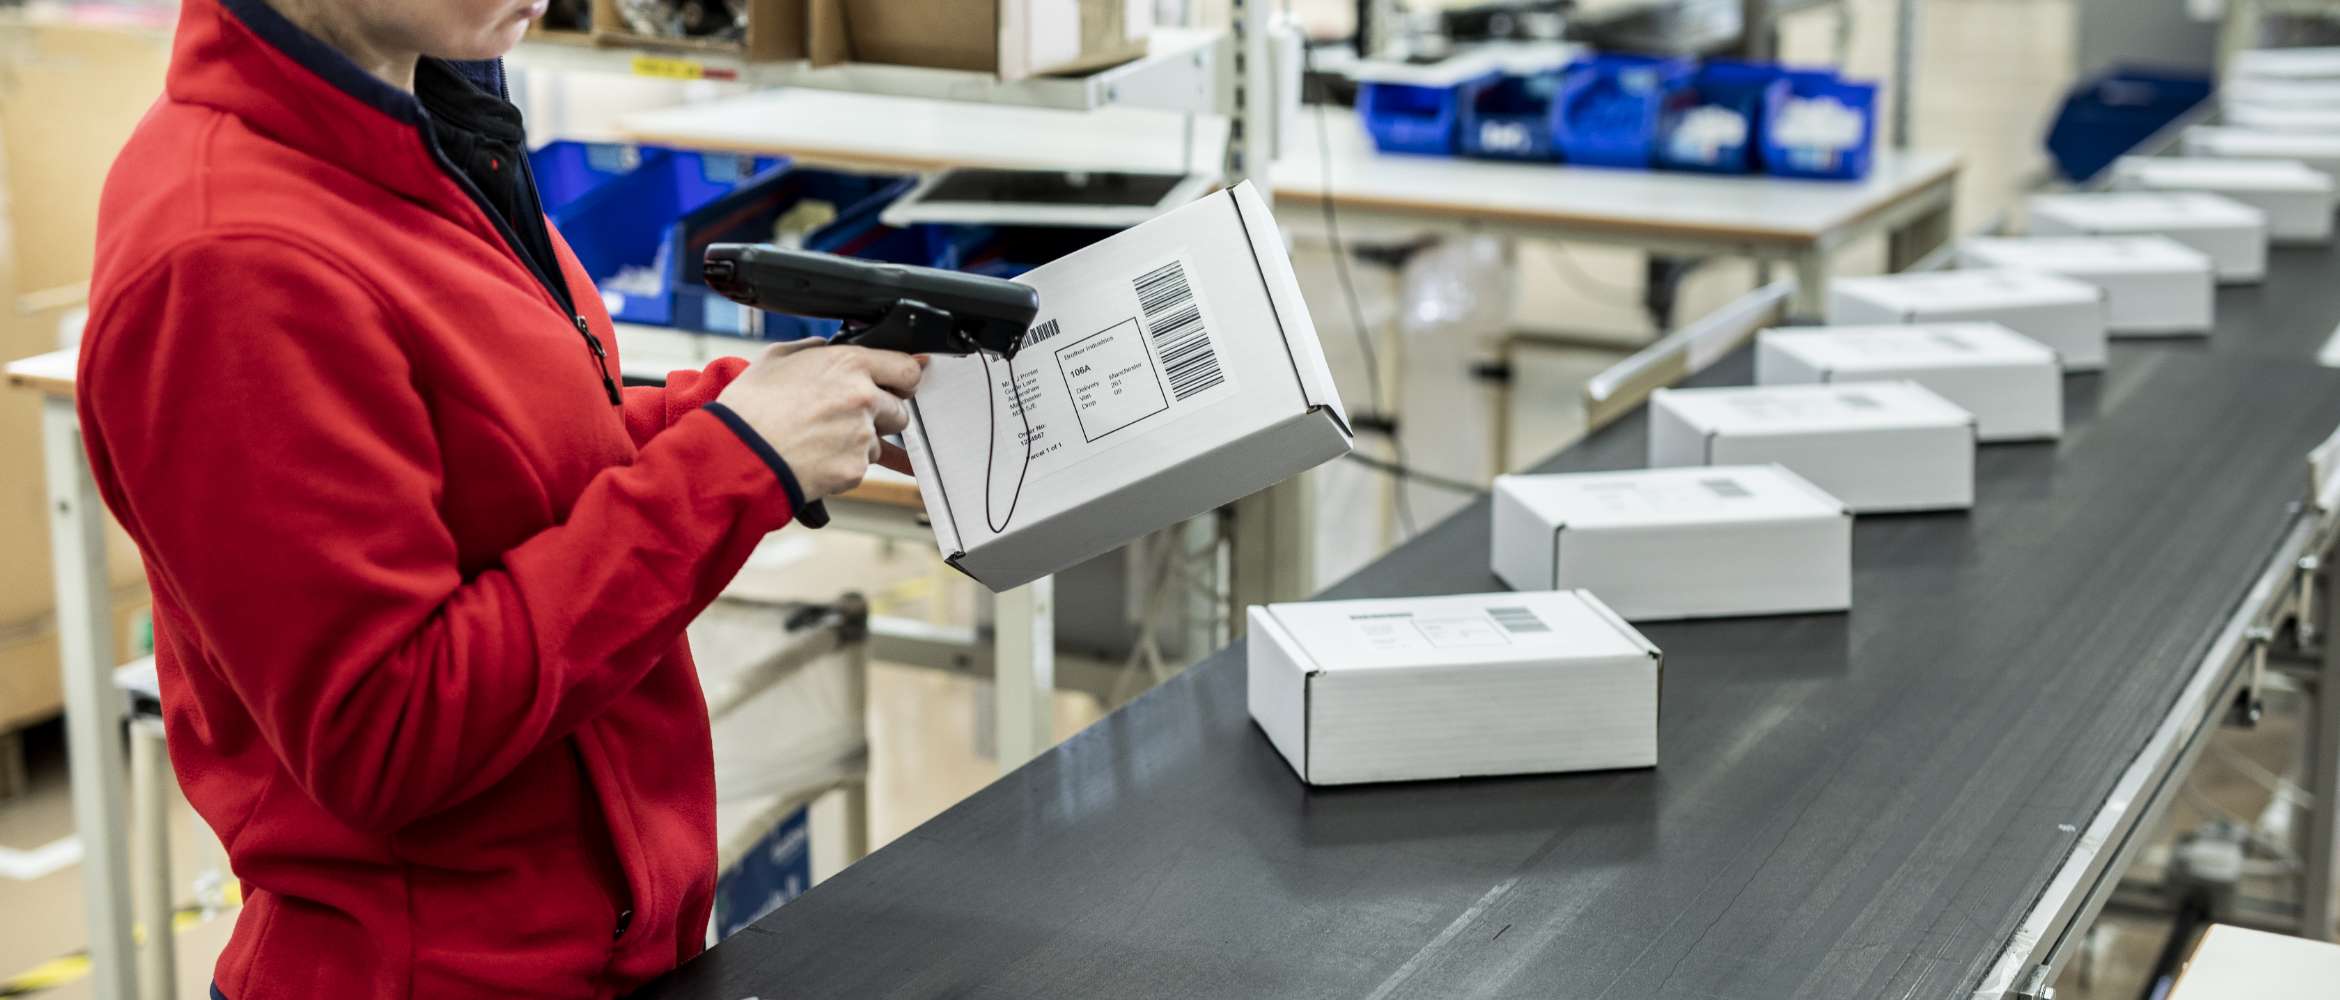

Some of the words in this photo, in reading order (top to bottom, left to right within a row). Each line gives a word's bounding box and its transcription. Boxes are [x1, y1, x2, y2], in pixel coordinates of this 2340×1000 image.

[1070, 365, 1091, 378] 106A
[1009, 393, 1041, 409] Machester
[1018, 429, 1035, 438] Orer
